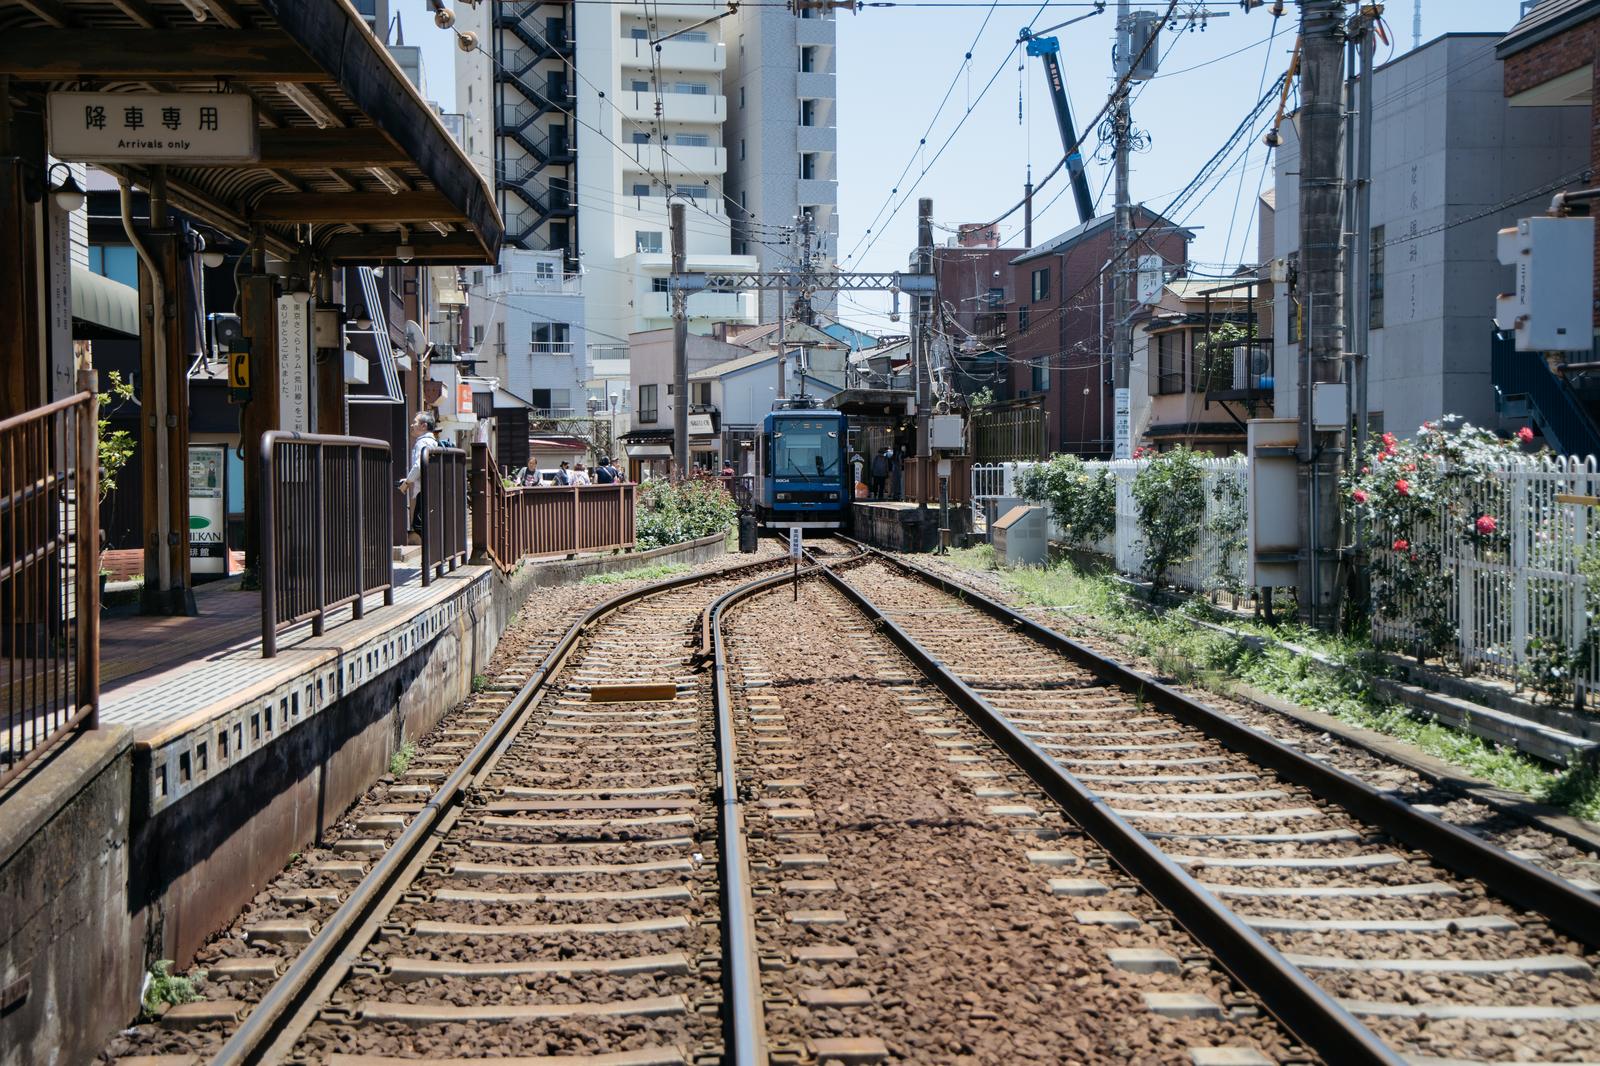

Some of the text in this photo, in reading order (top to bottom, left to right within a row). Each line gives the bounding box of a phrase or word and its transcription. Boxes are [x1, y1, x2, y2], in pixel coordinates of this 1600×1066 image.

[85, 105, 218, 131] 降車専用
[118, 139, 191, 150] Arrivals only
